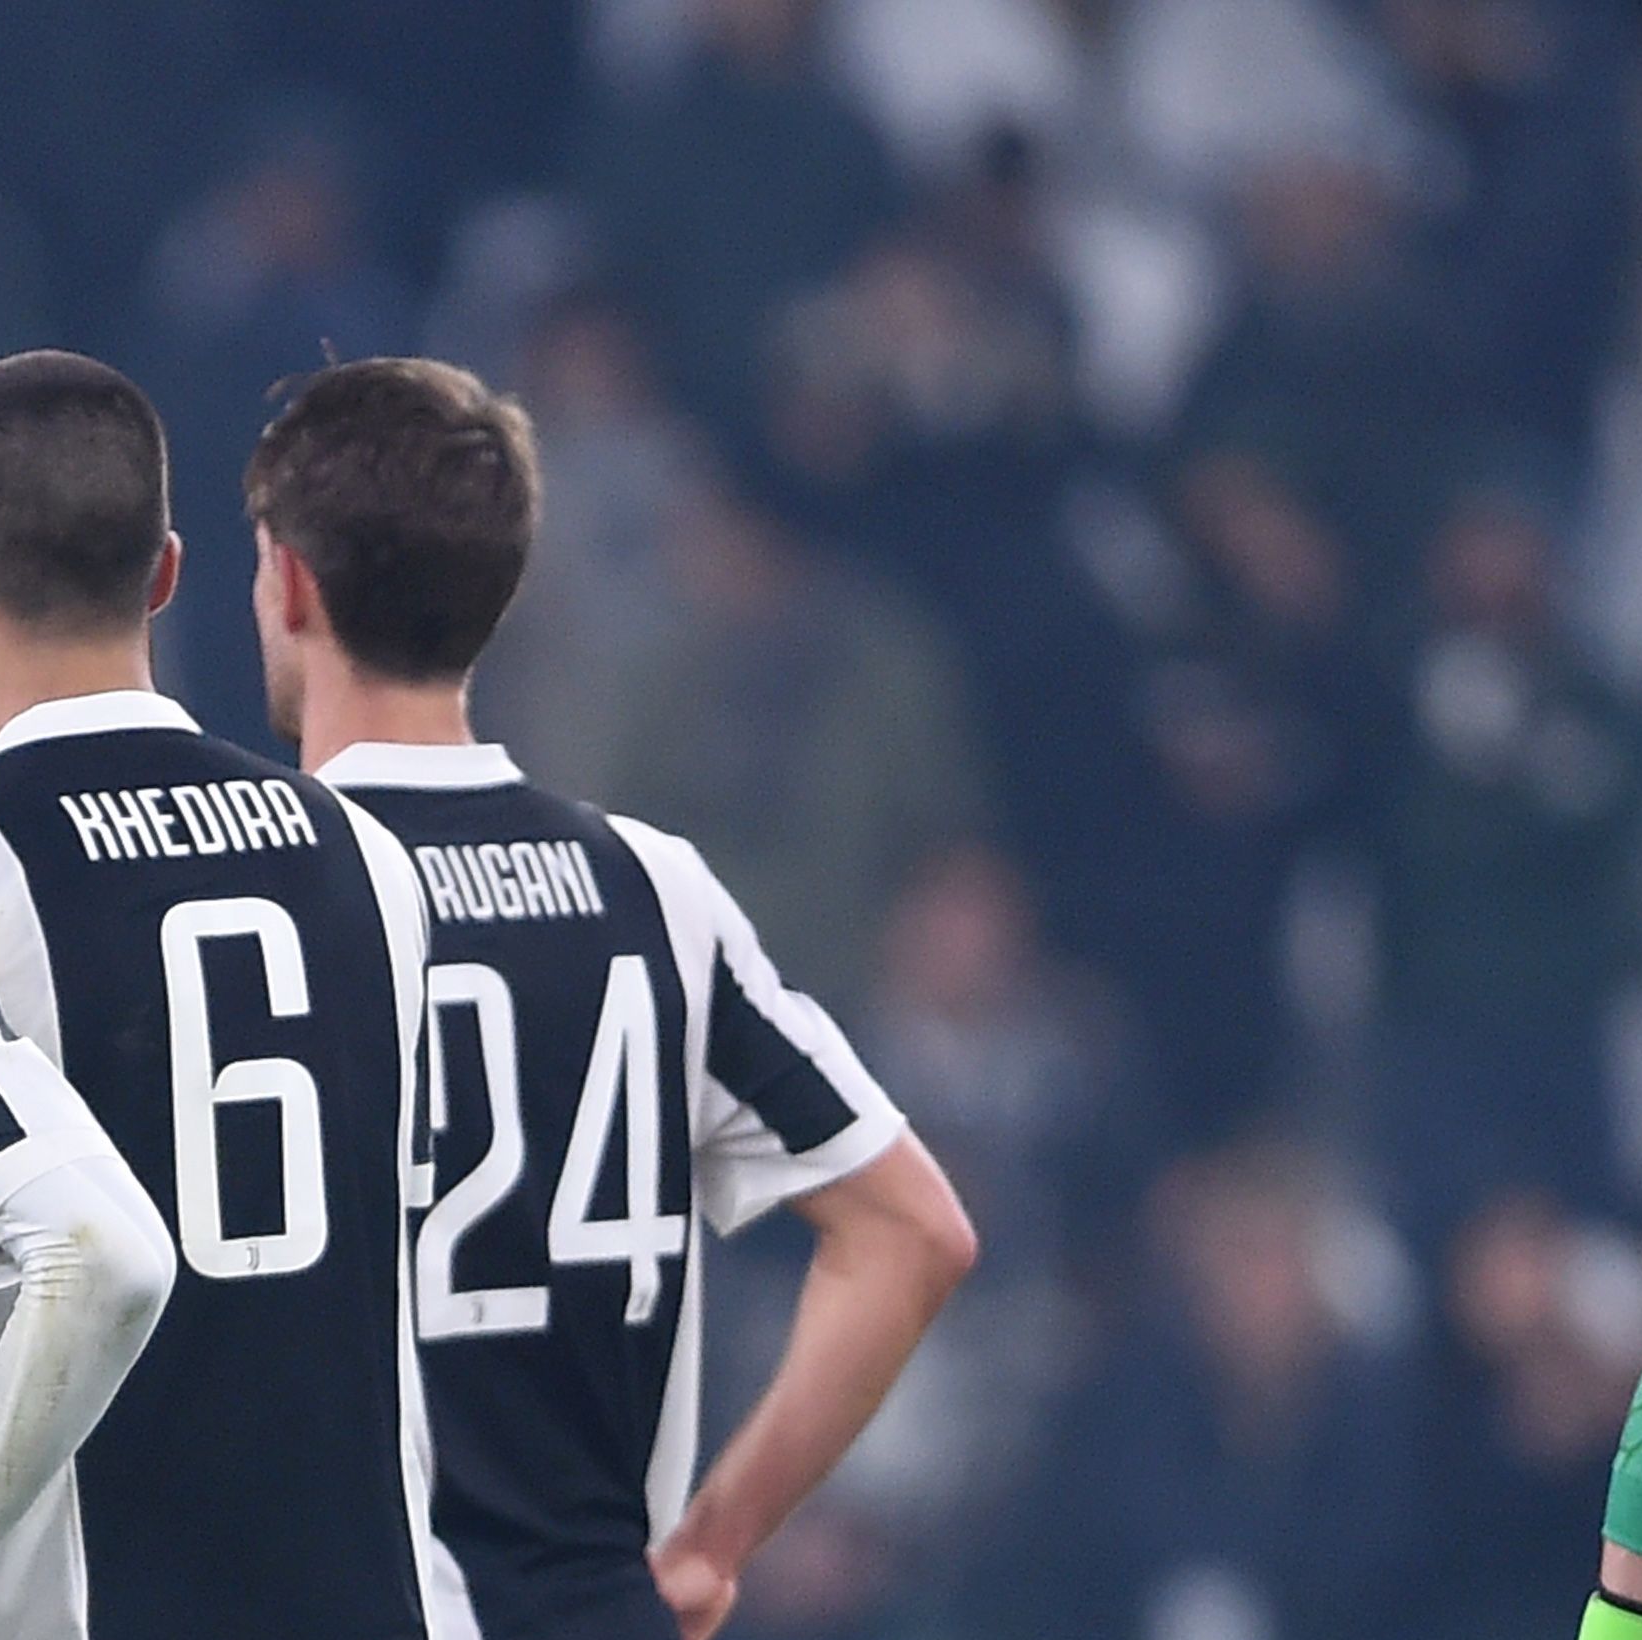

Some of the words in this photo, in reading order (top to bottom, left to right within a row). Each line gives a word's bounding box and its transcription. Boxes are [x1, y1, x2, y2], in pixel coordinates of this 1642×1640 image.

[59, 779, 318, 862] KHEDIRA
[414, 840, 605, 922] RUGANI
[161, 897, 328, 1280] 6
[417, 954, 687, 1342] 24
